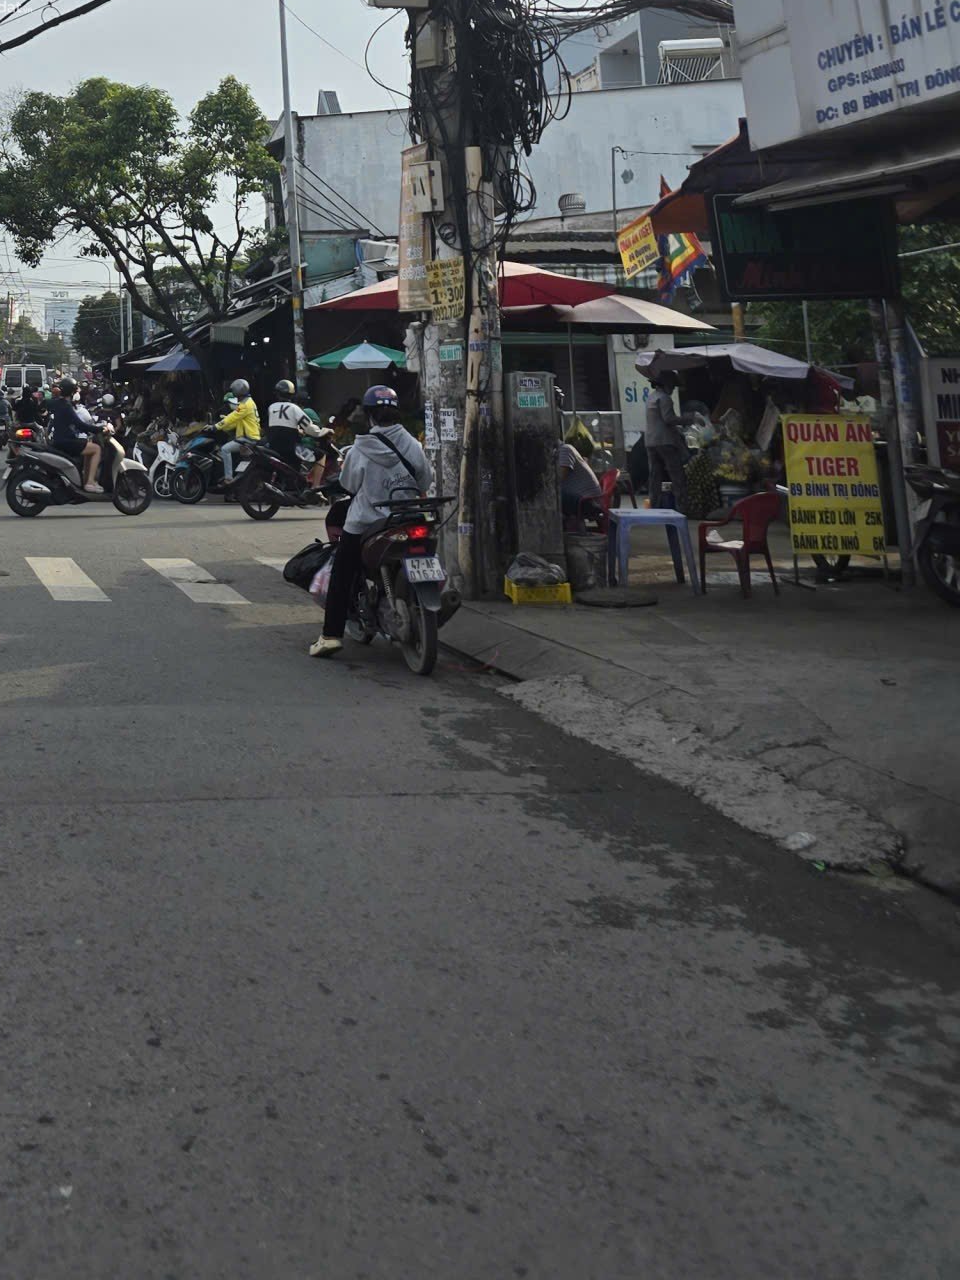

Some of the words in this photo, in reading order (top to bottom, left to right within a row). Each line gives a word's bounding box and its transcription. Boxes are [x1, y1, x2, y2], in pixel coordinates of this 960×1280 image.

[817, 33, 874, 70] CHUYÊN
[890, 14, 922, 45] BÁN
[925, 0, 947, 32] LẺ
[816, 107, 840, 124] ĐC:
[843, 100, 858, 115] 89
[863, 88, 894, 110] BÌNH
[897, 80, 920, 99] TRỊ
[925, 66, 960, 91] ĐÔNG
[625, 381, 638, 403] SỈ
[786, 419, 840, 443] QUÁN
[845, 419, 872, 442] ĂN
[805, 456, 860, 477] TIGER
[790, 483, 803, 496] 89
[806, 480, 830, 497] BÌNH
[833, 483, 849, 500] TRỊ
[851, 481, 880, 497] ĐÔNG
[792, 506, 817, 525] BÁNH
[819, 506, 837, 525] XÈO
[839, 506, 856, 526] LỚN
[865, 511, 883, 526] 25K
[793, 531, 819, 550] BÁNH
[820, 531, 838, 550] XÈO
[840, 531, 860, 551] NHỎ
[872, 536, 886, 551] 6K
